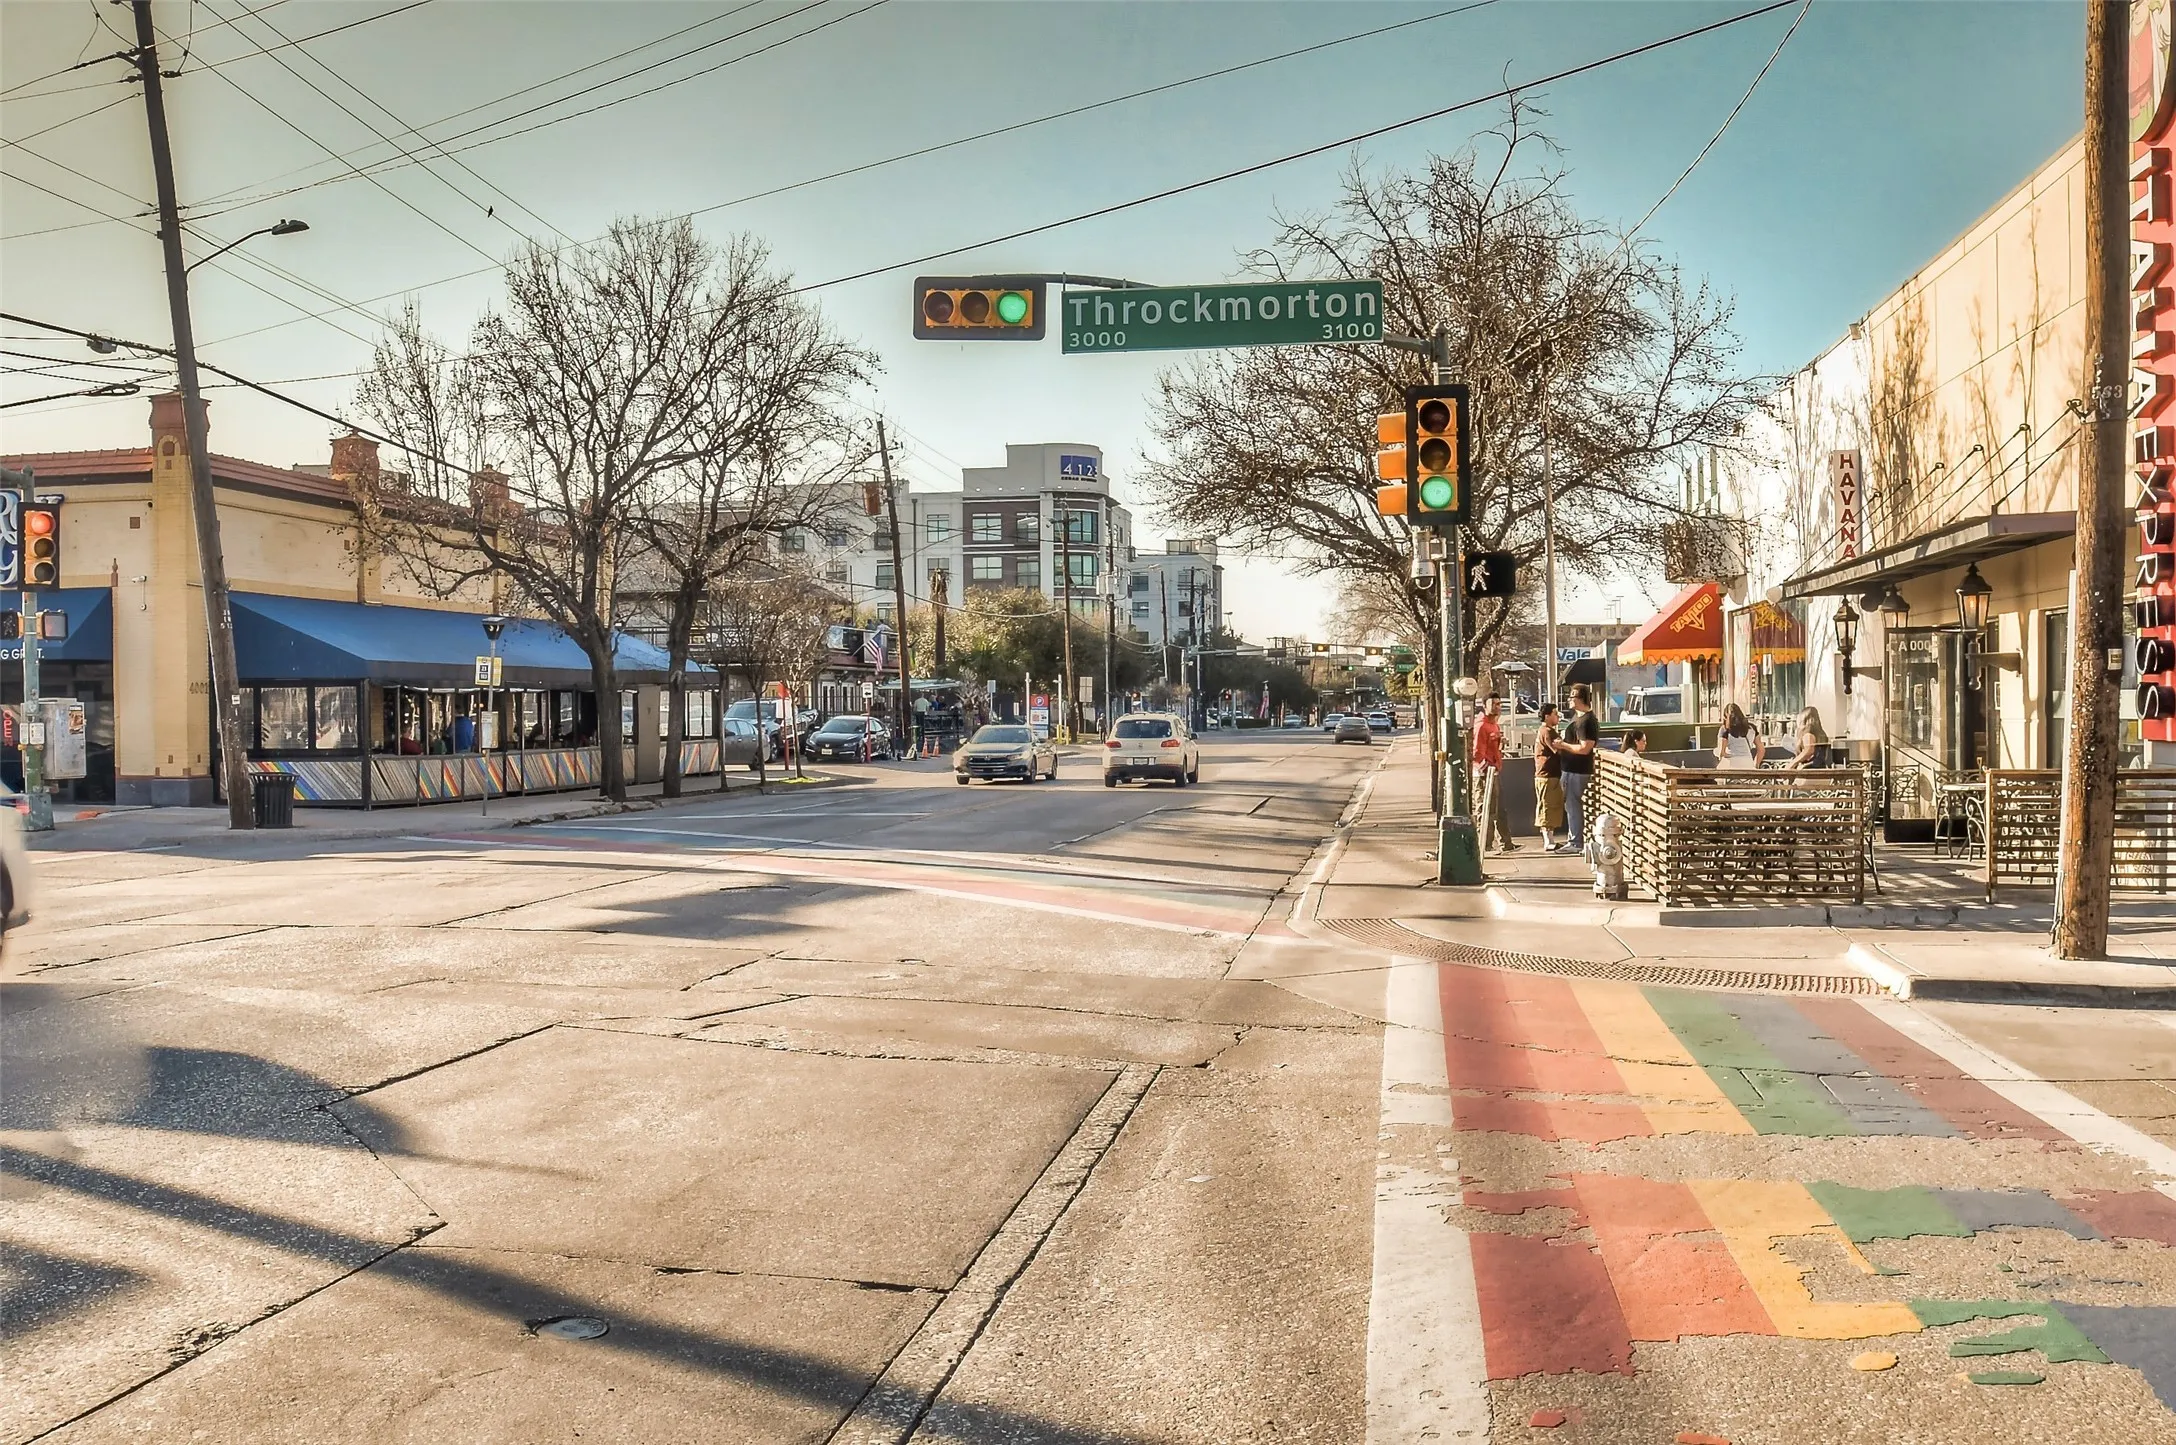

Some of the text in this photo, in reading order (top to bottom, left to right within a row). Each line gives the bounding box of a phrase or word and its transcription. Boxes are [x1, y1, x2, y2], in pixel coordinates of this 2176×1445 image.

[1068, 290, 1376, 326] Throckmorton
[1069, 331, 1126, 347] 3000
[1322, 322, 1375, 339] 3100
[1839, 454, 1857, 558] HAVANA
[2134, 425, 2160, 720] EXPRESS
[1669, 593, 1713, 632] TATTOO
